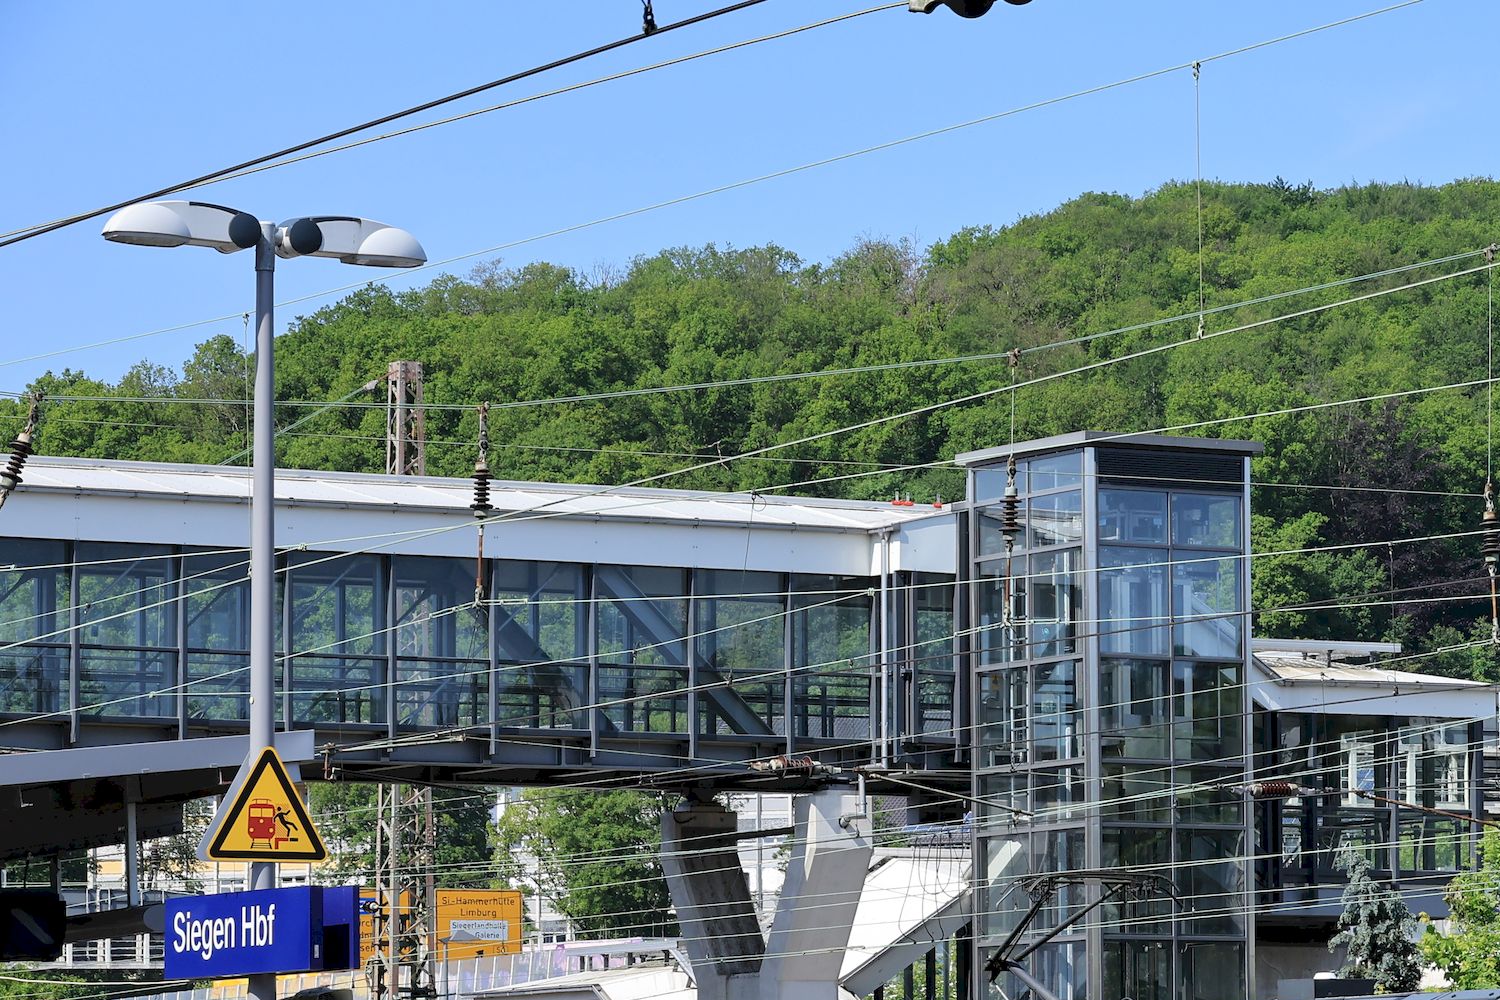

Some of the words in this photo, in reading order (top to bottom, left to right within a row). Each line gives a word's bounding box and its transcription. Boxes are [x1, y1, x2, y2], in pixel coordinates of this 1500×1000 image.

[460, 908, 497, 918] Limburg
[173, 911, 236, 960] Siegen
[241, 903, 276, 948] Hbf
